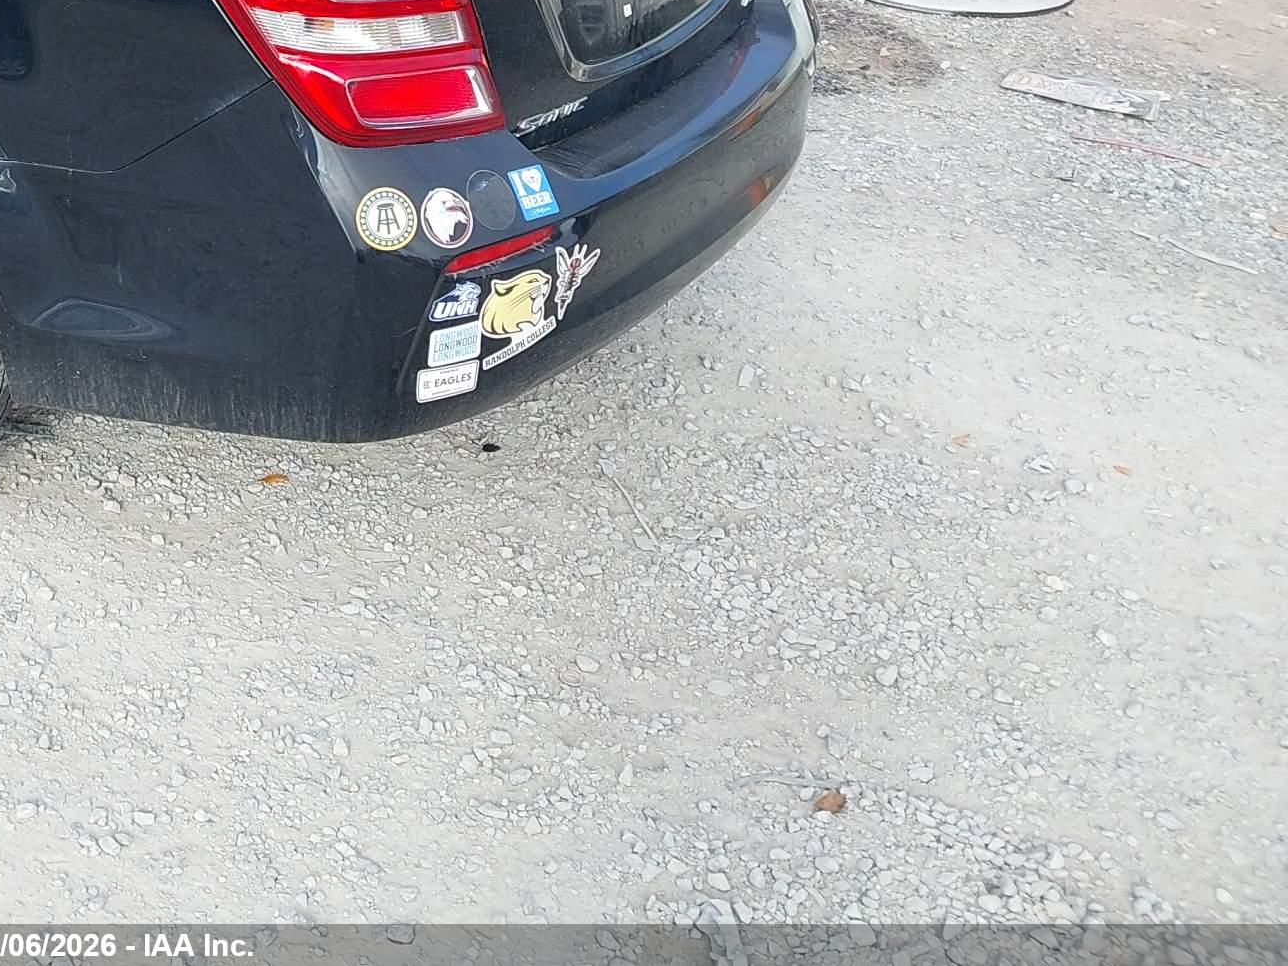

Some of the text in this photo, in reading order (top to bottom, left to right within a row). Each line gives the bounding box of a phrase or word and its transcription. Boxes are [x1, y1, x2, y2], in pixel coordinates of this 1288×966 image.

[432, 300, 478, 319] UNH
[433, 323, 479, 344] LONGWOOD
[433, 334, 478, 354] LONGWOOD
[484, 319, 555, 368] RANDOLPH COLLEGE
[432, 344, 477, 363] LONGWOOD
[434, 372, 472, 388] EAGLES
